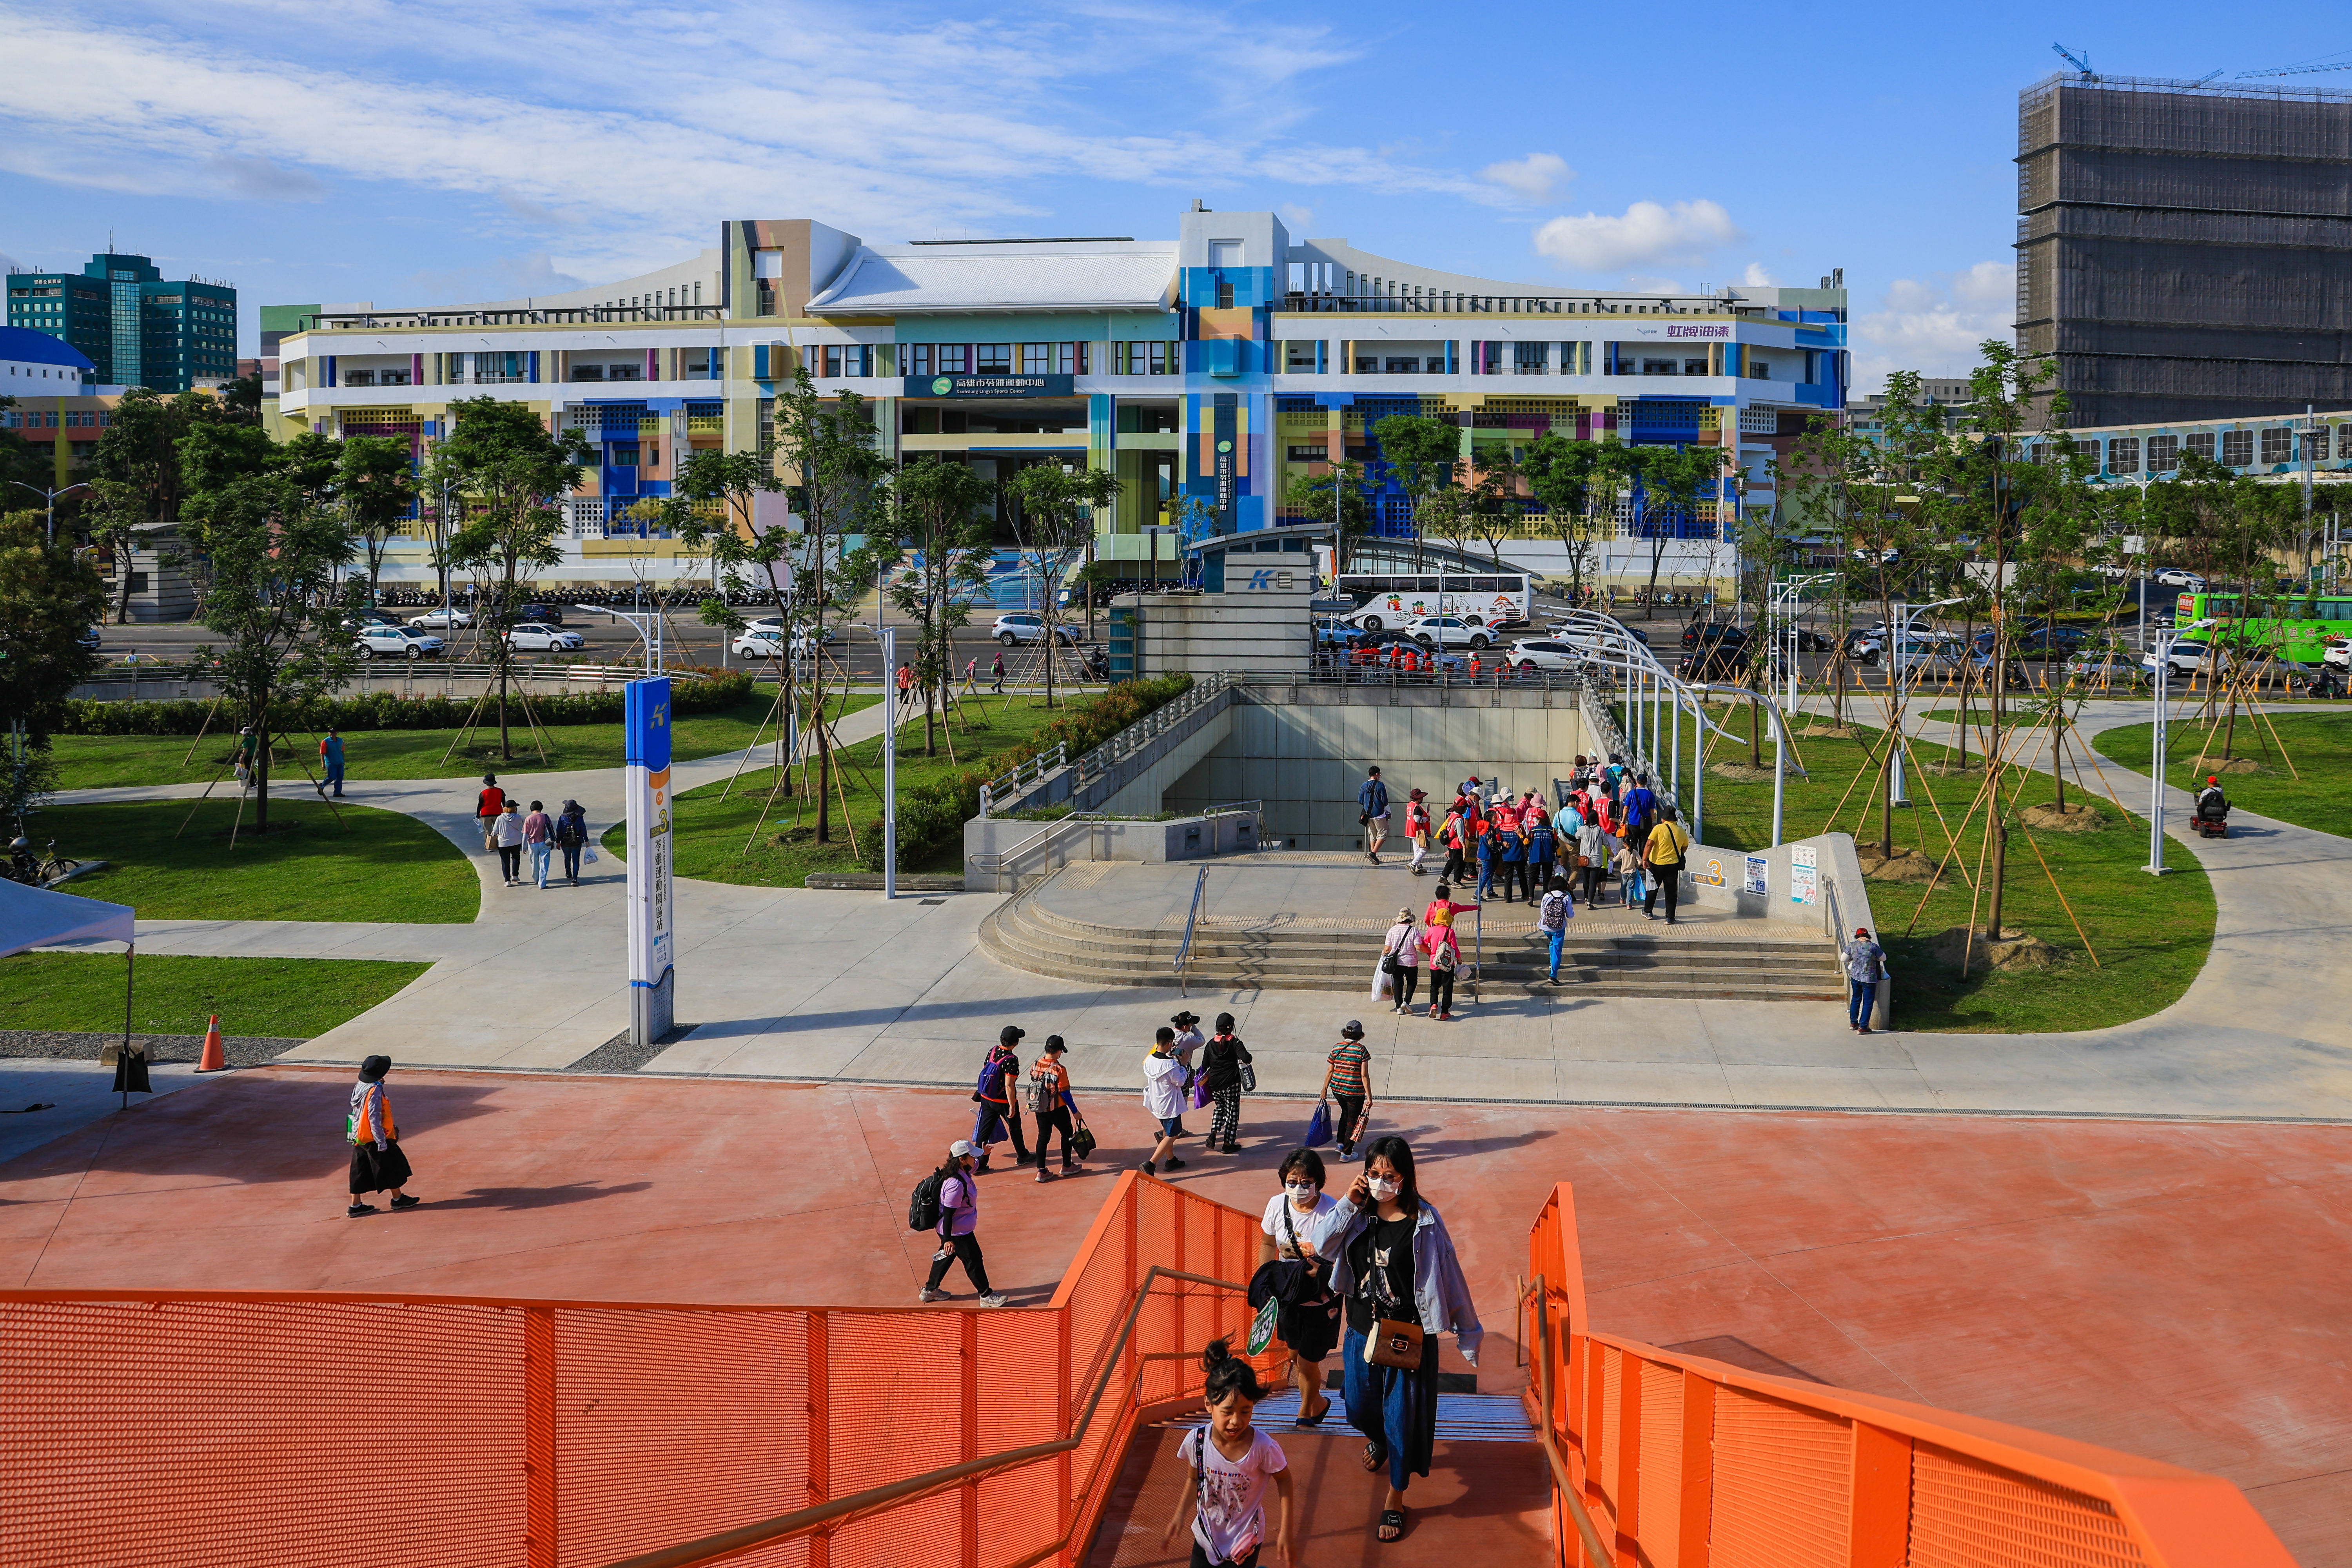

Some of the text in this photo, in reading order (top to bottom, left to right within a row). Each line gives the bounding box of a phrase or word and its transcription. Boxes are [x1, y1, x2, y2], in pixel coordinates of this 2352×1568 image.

[1667, 325, 1730, 337] 虹牌油漆
[956, 378, 1044, 387] 高雄市苓雅運動中心
[659, 809, 667, 832] 3
[1708, 860, 1722, 886] 3
[655, 839, 663, 931] 苓雅運動園區站
[663, 943, 666, 951] 1
[1243, 1069, 1252, 1089] Roots
